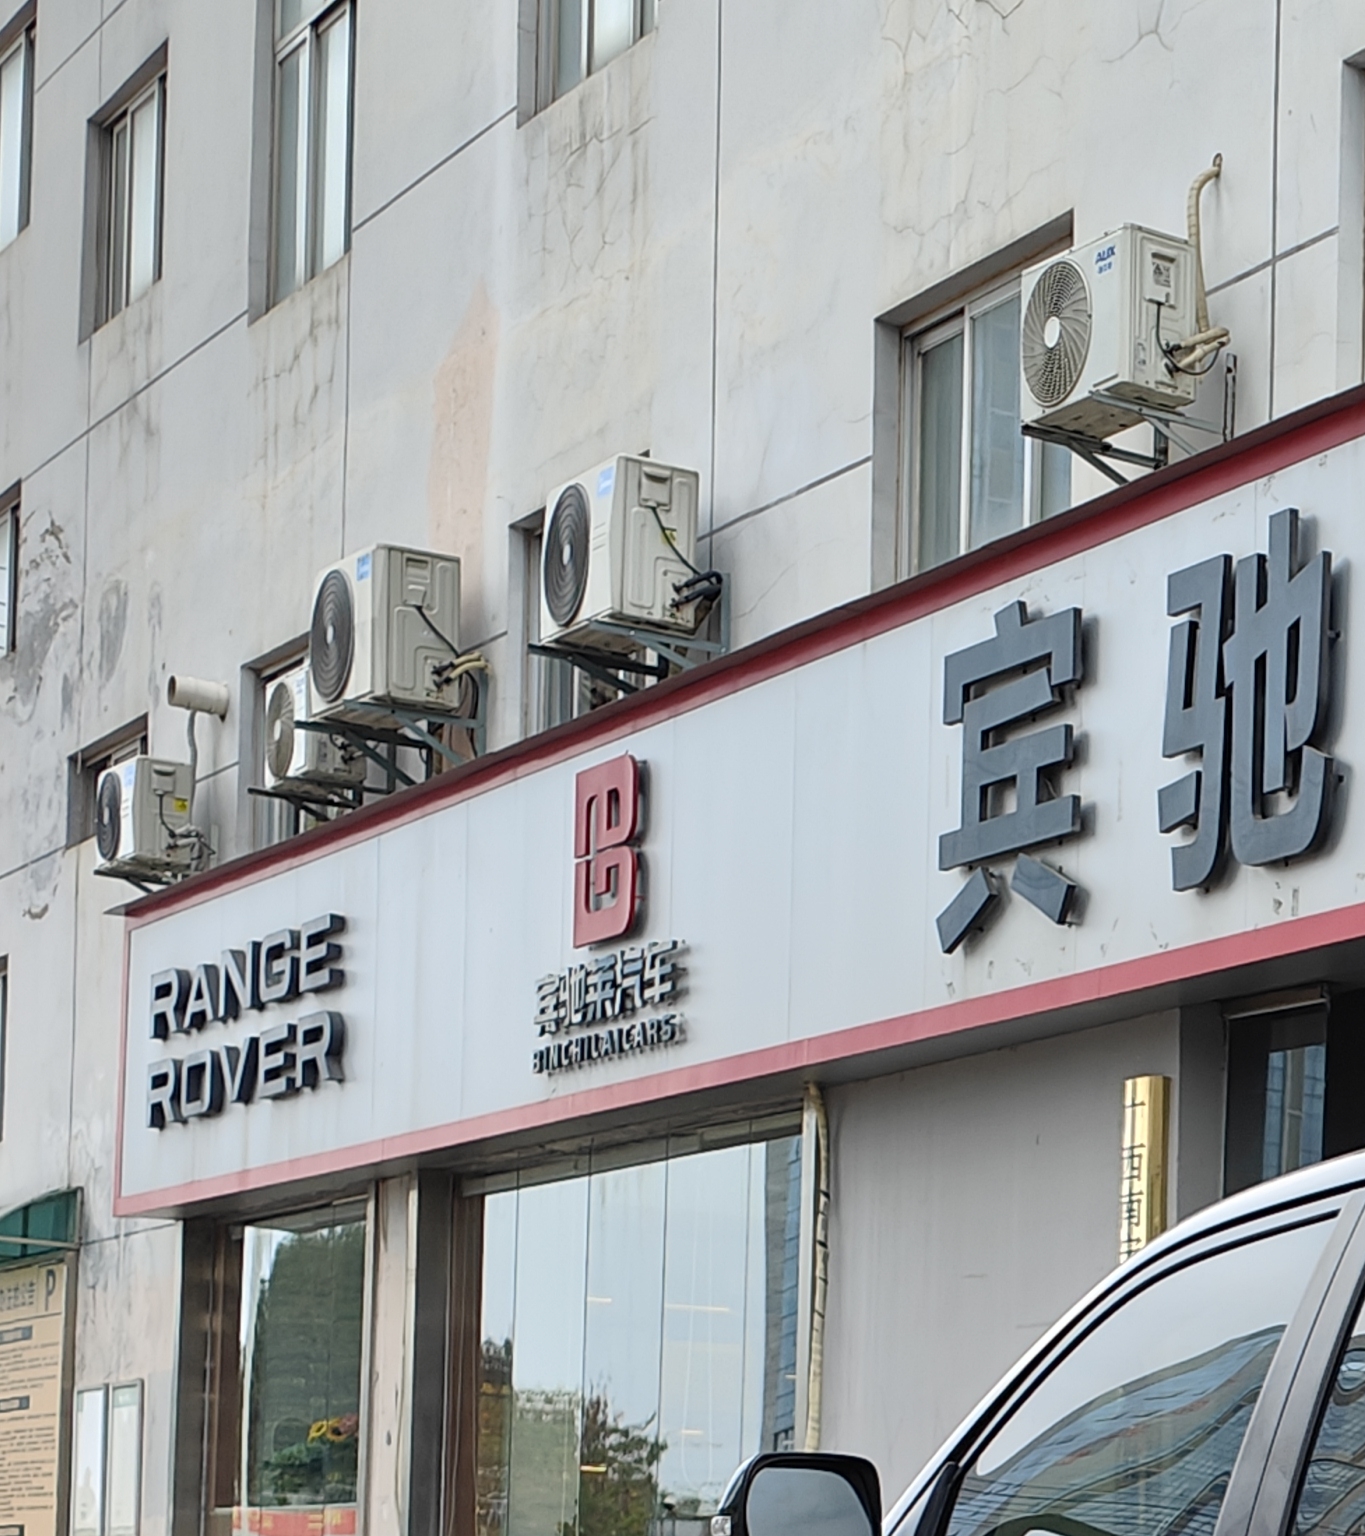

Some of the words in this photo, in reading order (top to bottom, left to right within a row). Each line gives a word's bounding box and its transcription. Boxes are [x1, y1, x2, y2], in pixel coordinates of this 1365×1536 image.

[150, 913, 345, 1041] RANGE
[534, 939, 680, 1037] 宾驰莱汽车
[147, 1010, 345, 1129] ROVER
